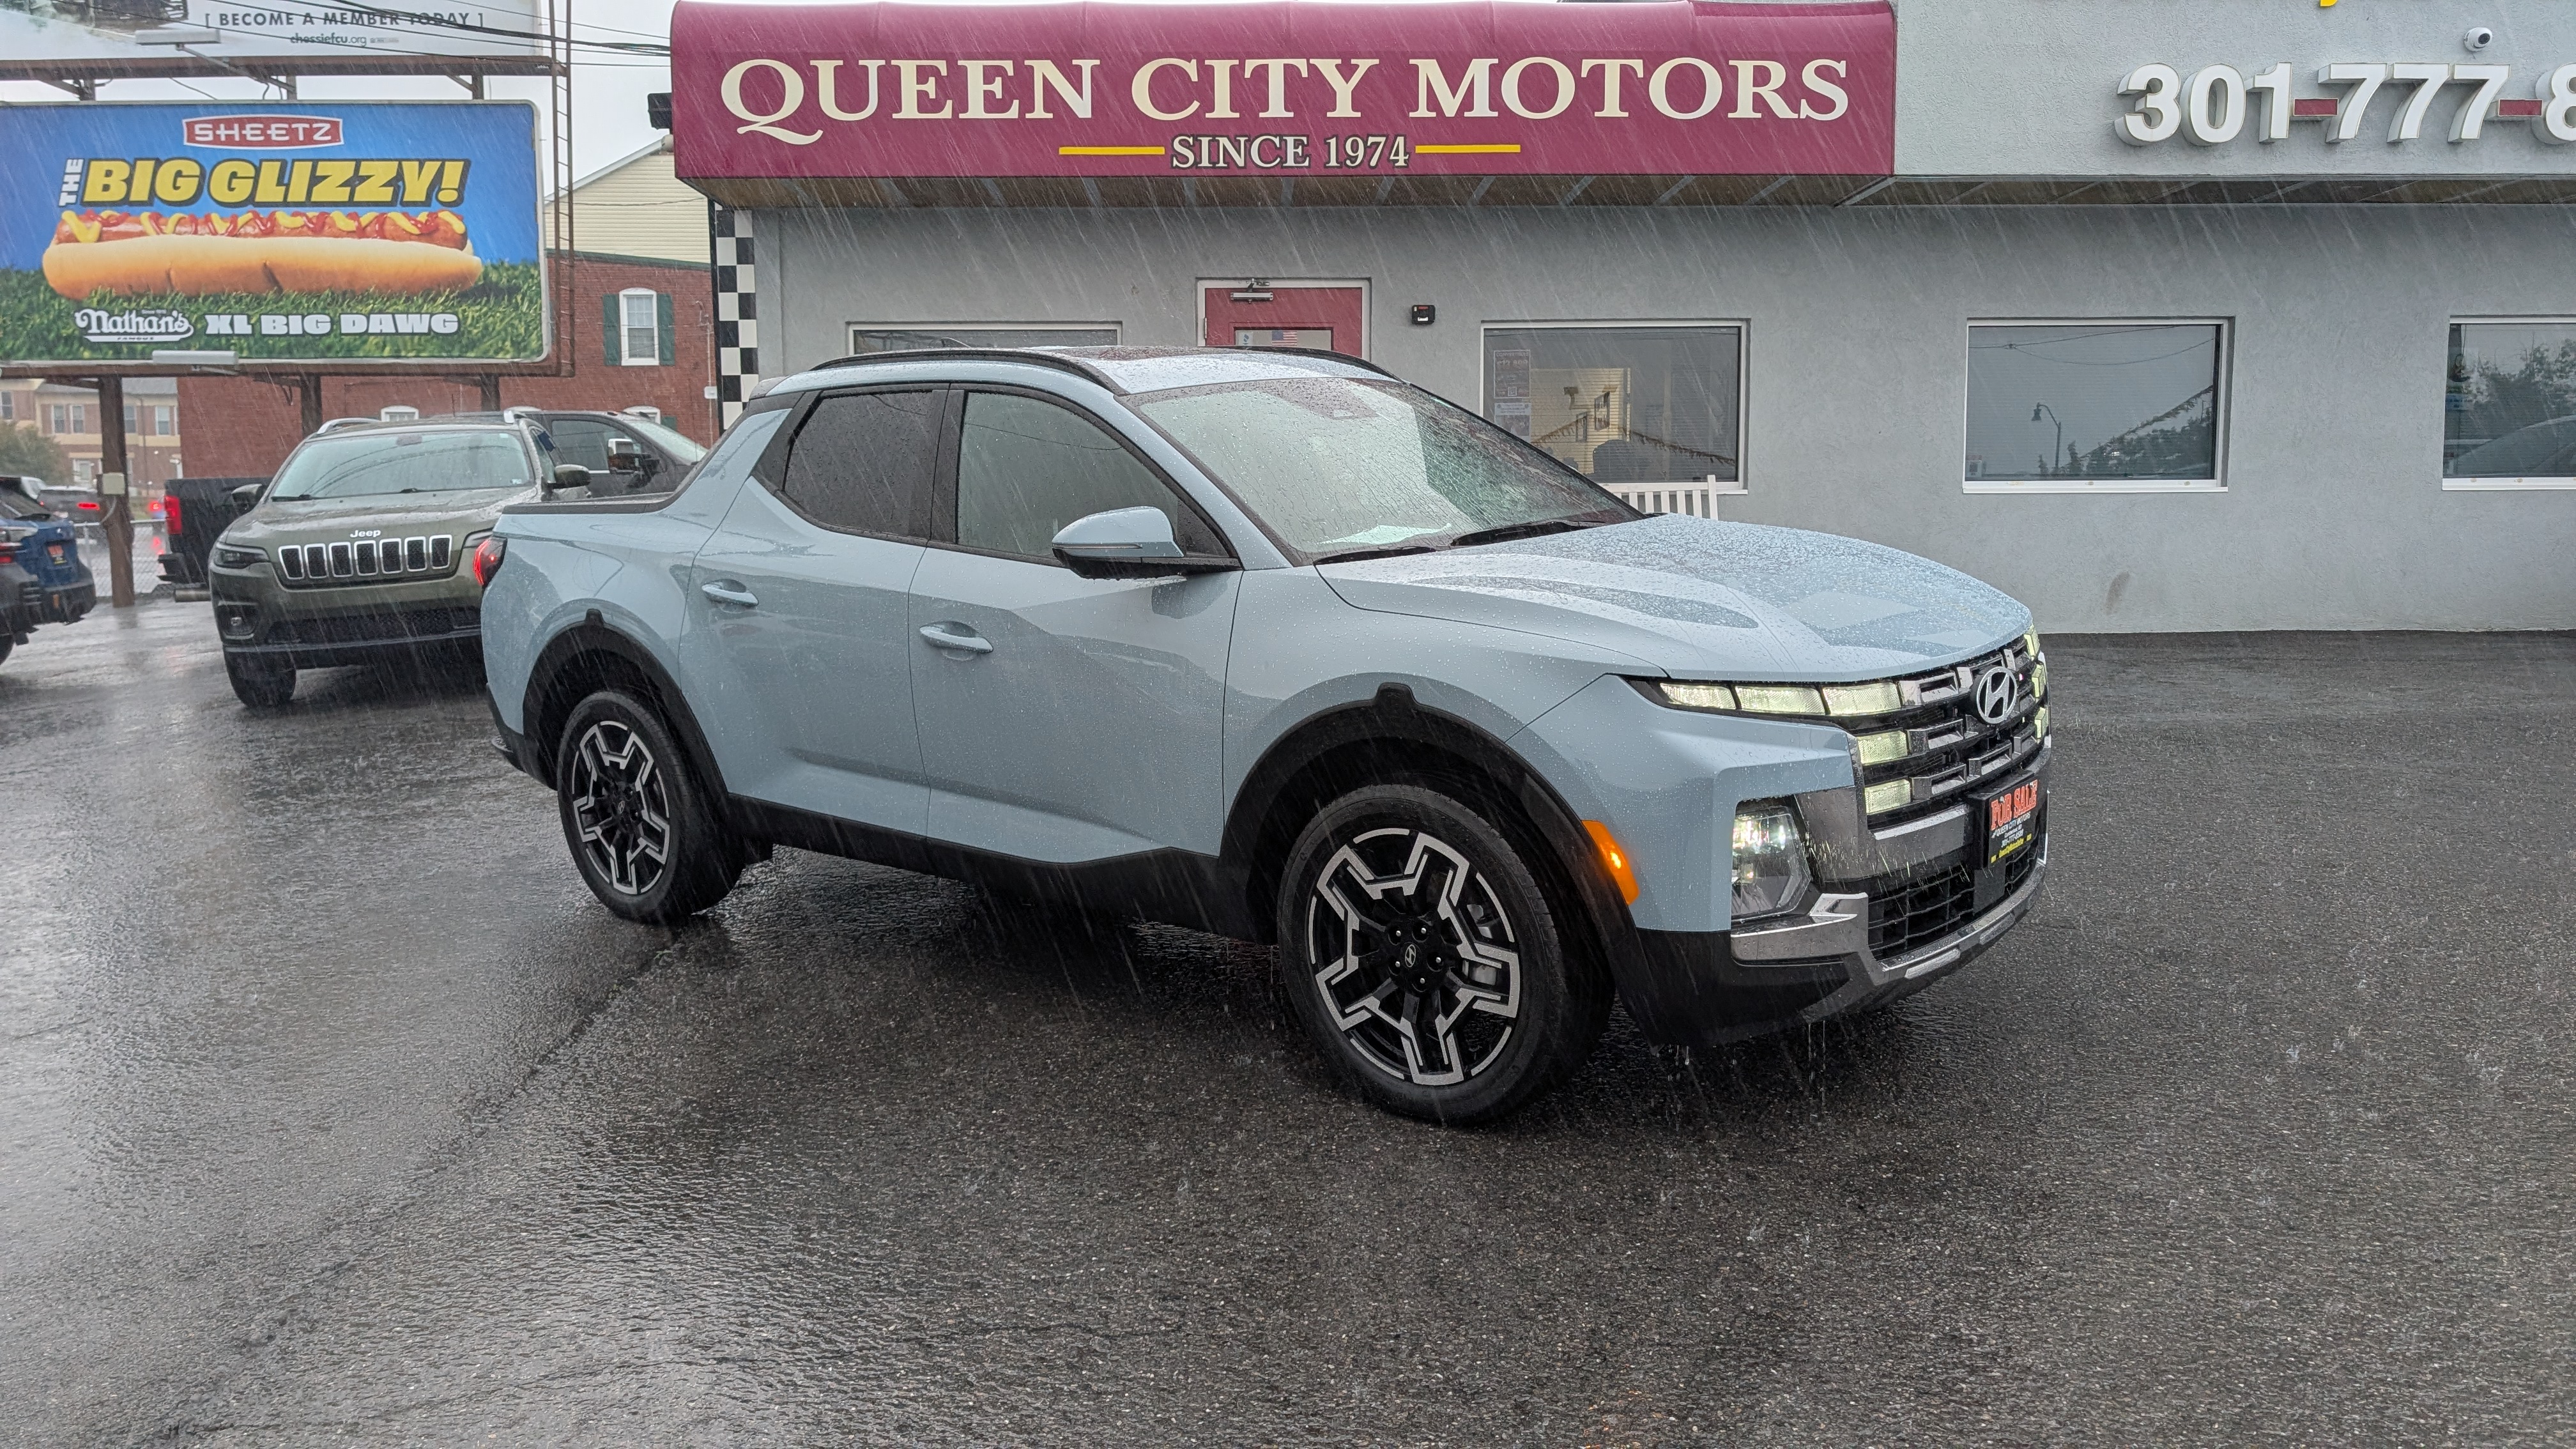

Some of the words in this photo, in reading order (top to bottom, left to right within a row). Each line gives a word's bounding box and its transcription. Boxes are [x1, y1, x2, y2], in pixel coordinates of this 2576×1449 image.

[219, 13, 294, 26] BECOME
[302, 13, 314, 25] A
[323, 12, 400, 26] MEMBER
[721, 59, 1101, 145] QUEEN
[1131, 58, 1379, 121] CITY
[1409, 57, 1848, 121] MOTORS
[194, 123, 332, 141] SHEETZ
[1172, 135, 1310, 168] SINCE
[1324, 135, 1410, 167] 1974
[59, 158, 84, 206] THE
[84, 160, 201, 203] BIG
[210, 160, 466, 204] GLIZZY!
[74, 309, 194, 334] Nathan's
[204, 315, 252, 334] XL
[261, 314, 331, 334] BIG
[341, 314, 458, 334] DAWG
[349, 530, 381, 538] Jeep
[1991, 793, 2012, 831] FOR
[2013, 779, 2038, 818] SALE
